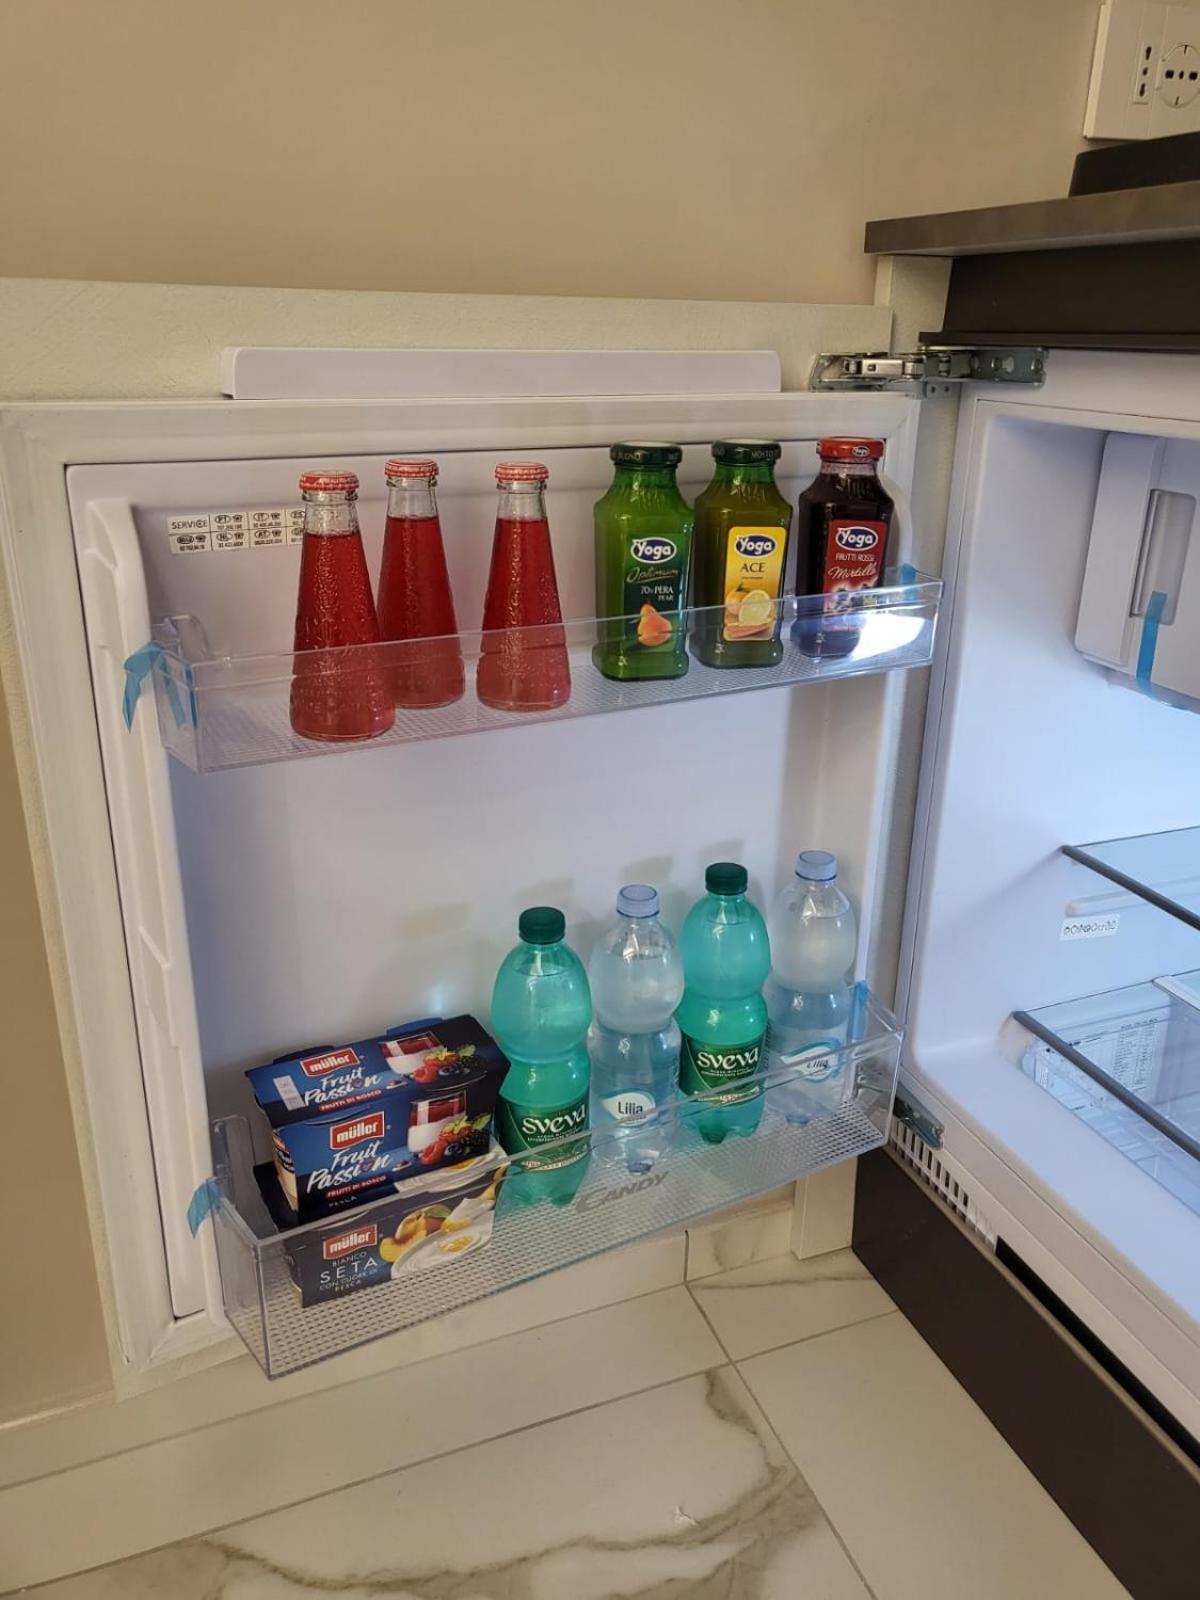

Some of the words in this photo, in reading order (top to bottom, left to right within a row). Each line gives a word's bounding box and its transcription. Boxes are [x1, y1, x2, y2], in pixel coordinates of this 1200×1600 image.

[171, 519, 208, 530] SERVICE
[740, 537, 773, 555] Yoga
[840, 529, 874, 548] Yoga
[635, 541, 672, 560] Yoga
[740, 562, 767, 573] ACE
[654, 585, 674, 595] PERA
[309, 1054, 351, 1073] müller
[320, 1066, 367, 1091] Fruit
[617, 1101, 644, 1115] Lilia
[336, 1121, 379, 1144] müller
[331, 1139, 385, 1172] Fruit
[575, 1170, 670, 1213] CANDY
[329, 1231, 372, 1254] müller
[320, 1257, 379, 1284] SETA
